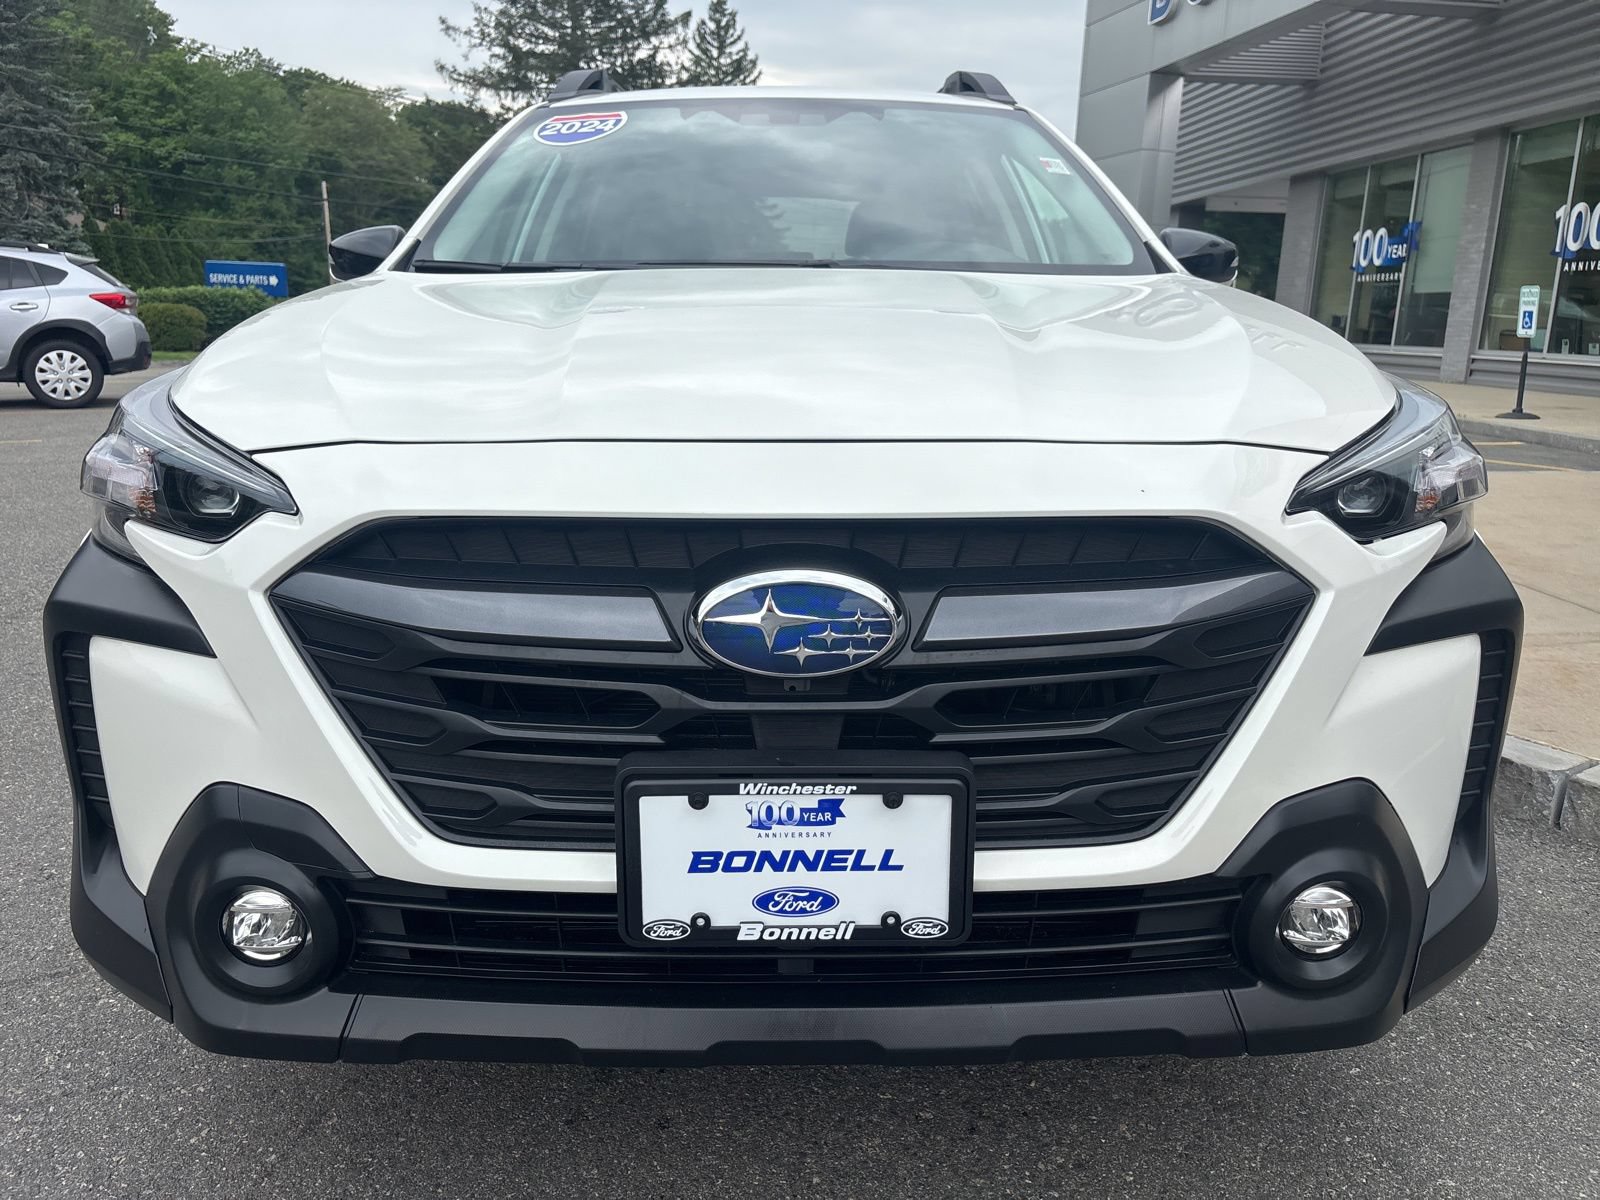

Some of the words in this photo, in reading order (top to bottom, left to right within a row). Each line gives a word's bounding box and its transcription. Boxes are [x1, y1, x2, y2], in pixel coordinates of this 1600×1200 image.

[540, 120, 616, 136] 2024
[1353, 227, 1389, 268] 100
[209, 272, 238, 284] SERVICE
[239, 274, 245, 285] &
[245, 274, 268, 286] PARTS
[1357, 272, 1403, 282] ANNIVERSARY
[739, 782, 858, 795] Winchester
[745, 799, 801, 827] 100
[802, 812, 832, 822] YEAR
[757, 831, 832, 839] ANNIVERSARY
[687, 849, 904, 874] BONNELL
[769, 890, 822, 912] Ford
[736, 921, 855, 942] Bonnell
